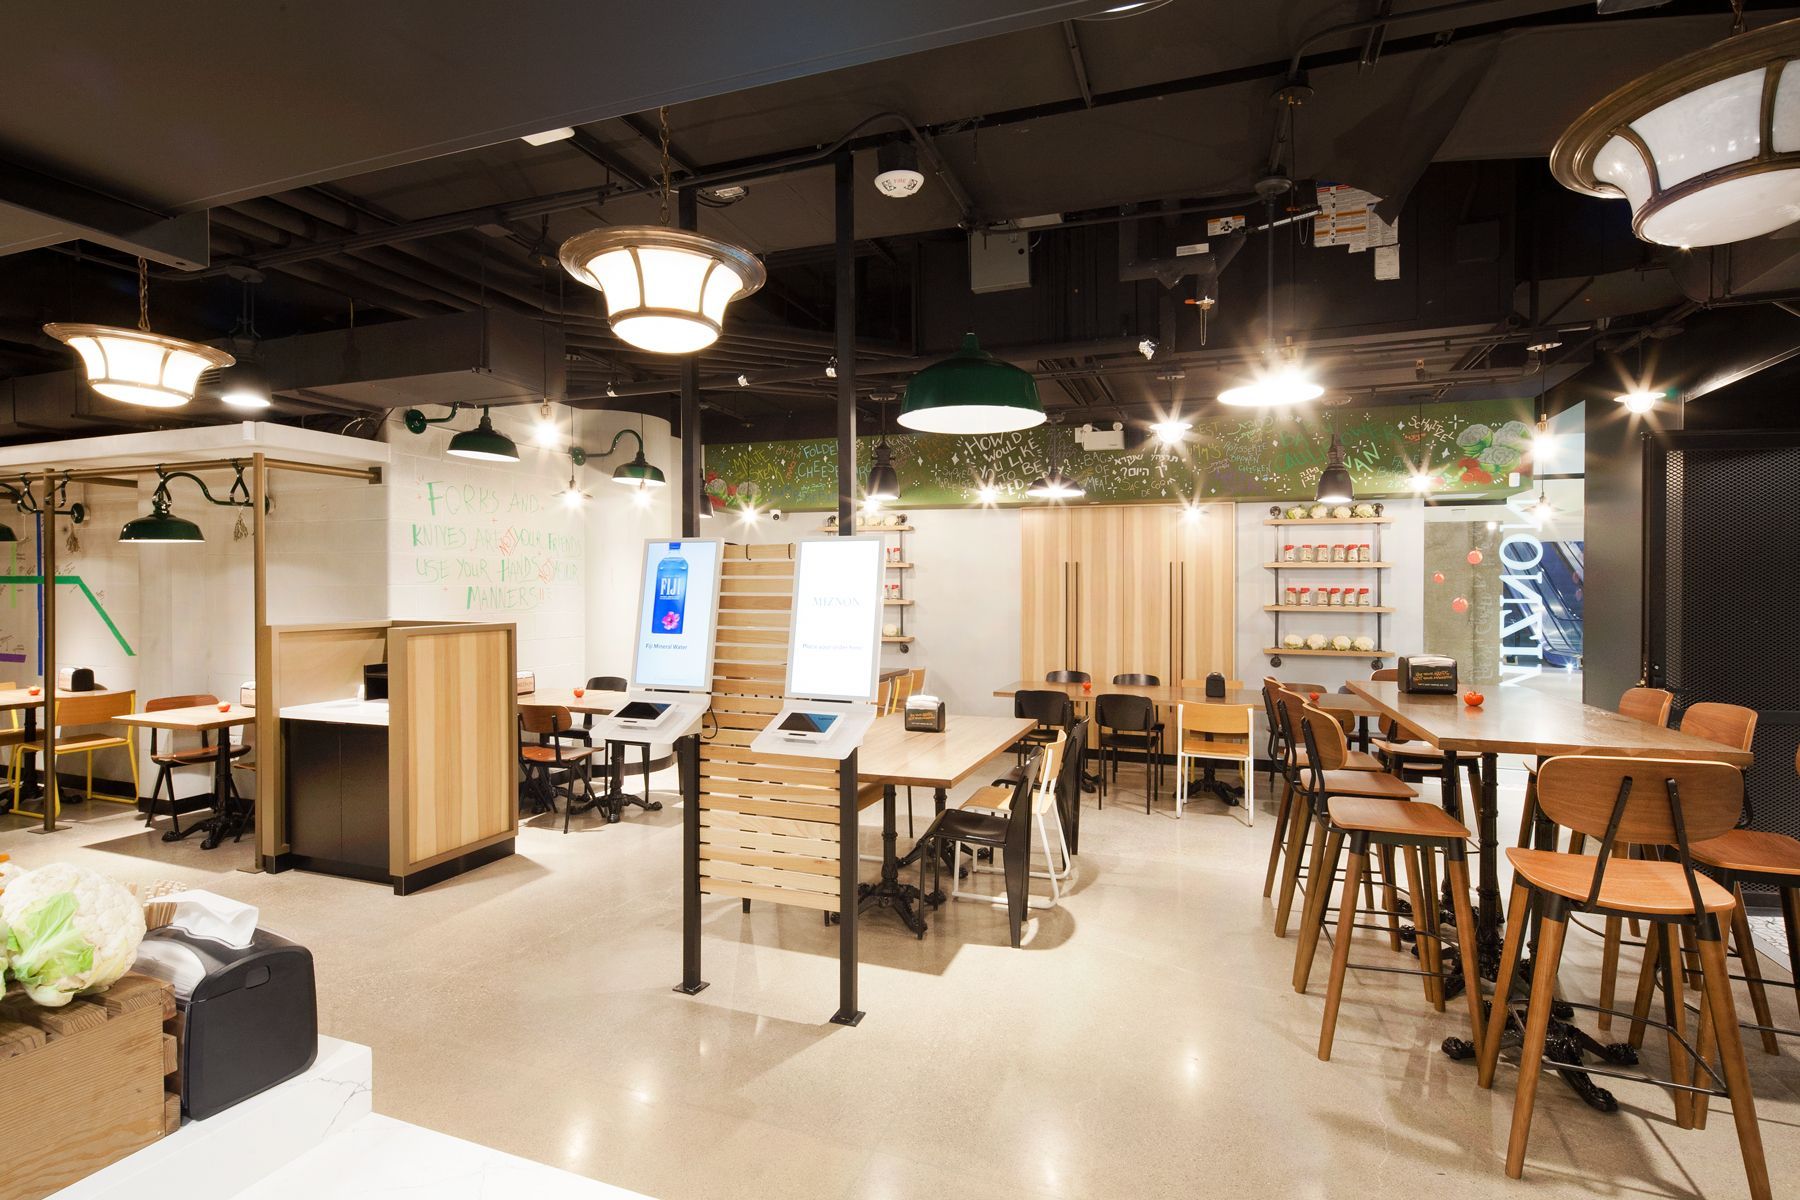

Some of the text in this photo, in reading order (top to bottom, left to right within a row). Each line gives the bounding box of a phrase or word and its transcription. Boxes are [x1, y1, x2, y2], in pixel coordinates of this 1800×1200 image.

[1408, 415, 1455, 443] SCHNITZEL
[964, 432, 1004, 455] HOW
[983, 431, 1022, 463] WOULD
[1007, 437, 1039, 467] LIKE
[749, 463, 785, 485] STEAK
[998, 470, 1016, 482] TO
[1021, 459, 1043, 475] BE
[1095, 464, 1109, 474] OF
[1084, 474, 1109, 492] MEAT
[412, 523, 467, 550] KNIVES
[416, 558, 449, 582] USE
[456, 558, 492, 583] YOUR
[497, 555, 538, 582] HANDS
[660, 577, 681, 596] FIJI
[812, 596, 862, 608] MIZNON
